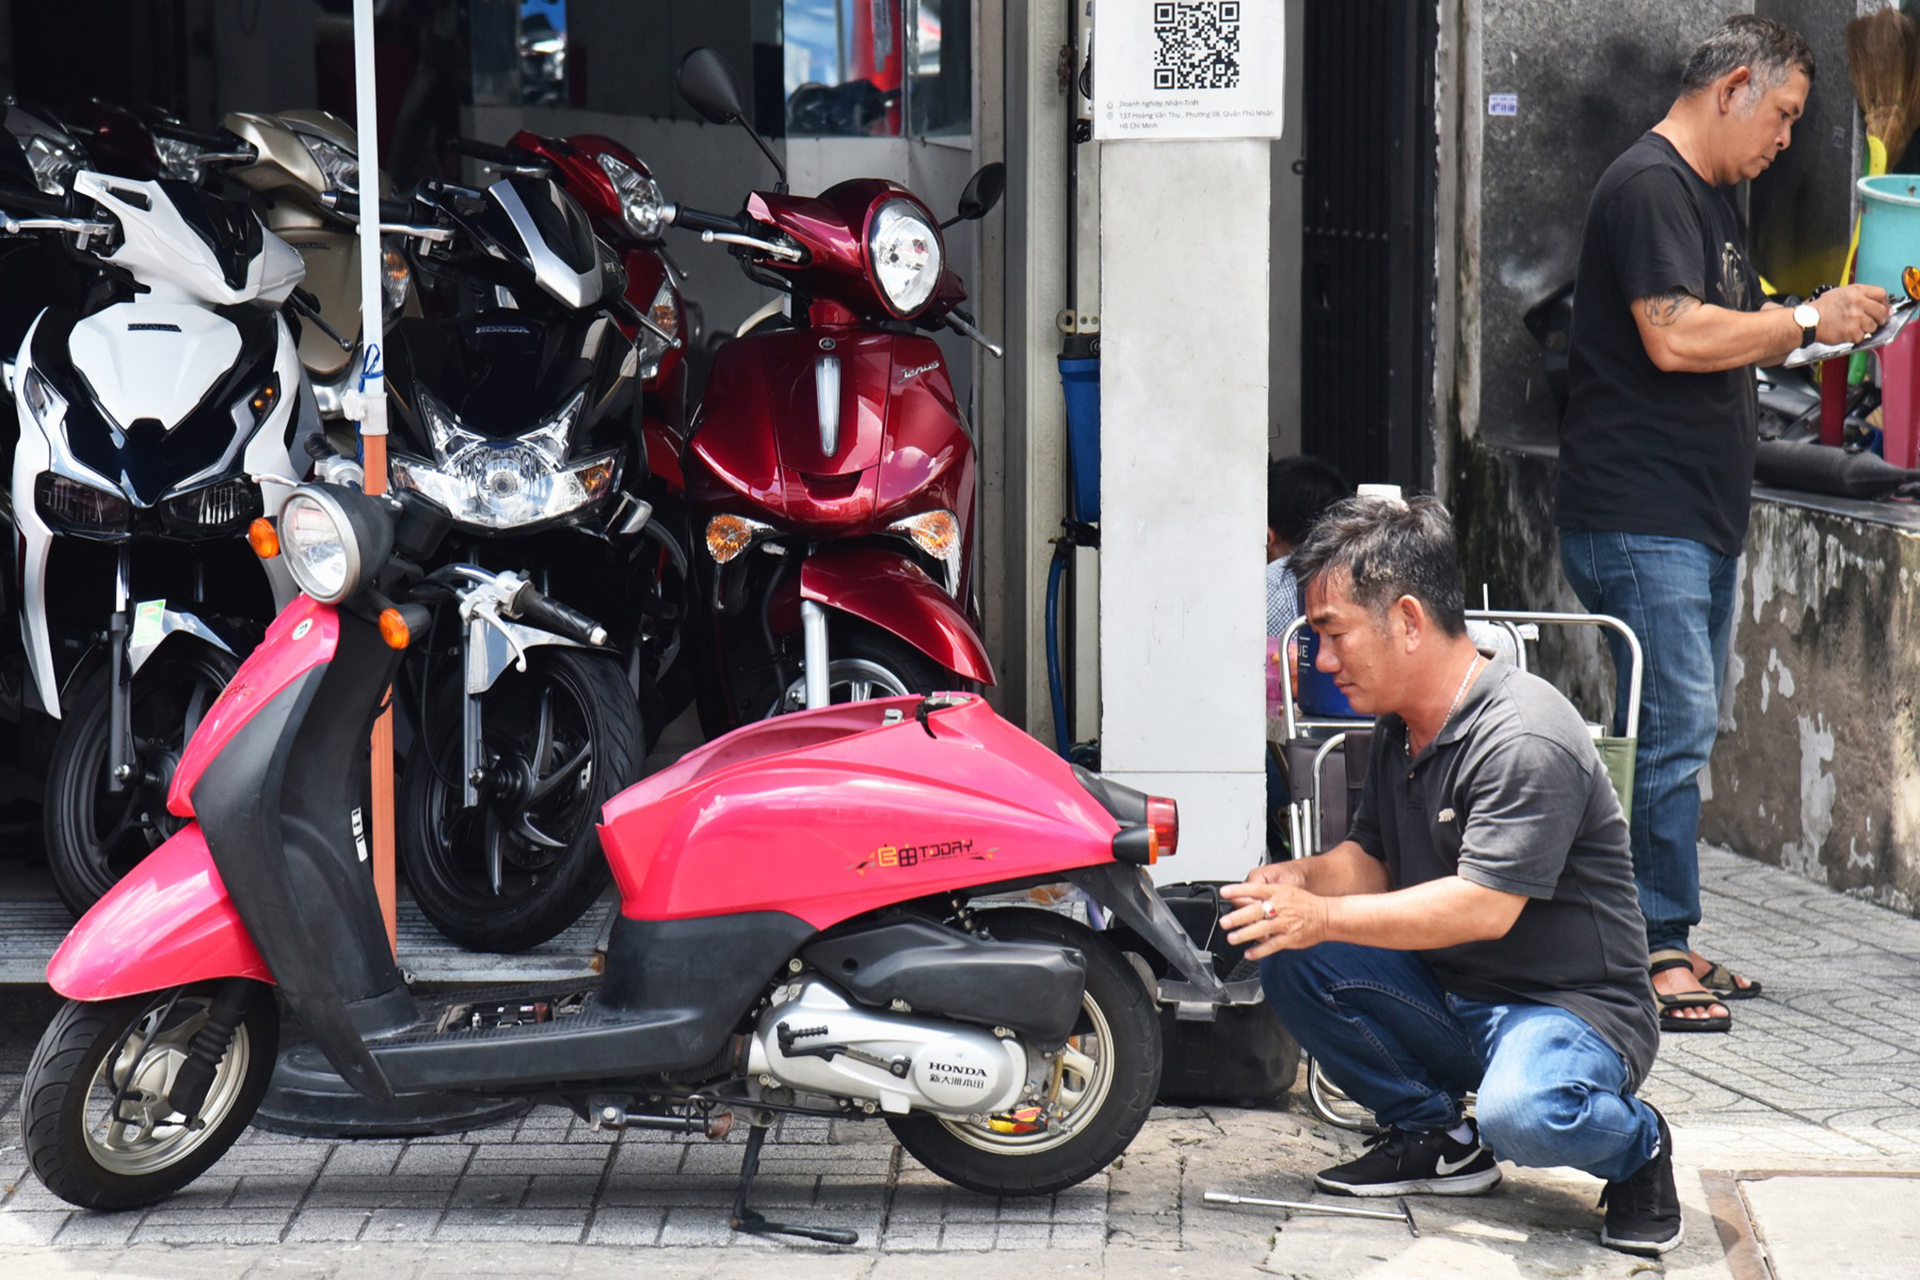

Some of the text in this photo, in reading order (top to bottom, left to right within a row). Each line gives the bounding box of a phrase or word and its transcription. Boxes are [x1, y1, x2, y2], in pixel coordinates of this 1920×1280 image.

[475, 325, 530, 334] HONDA
[918, 839, 973, 858] TODAY
[929, 1061, 987, 1077] HONDA
